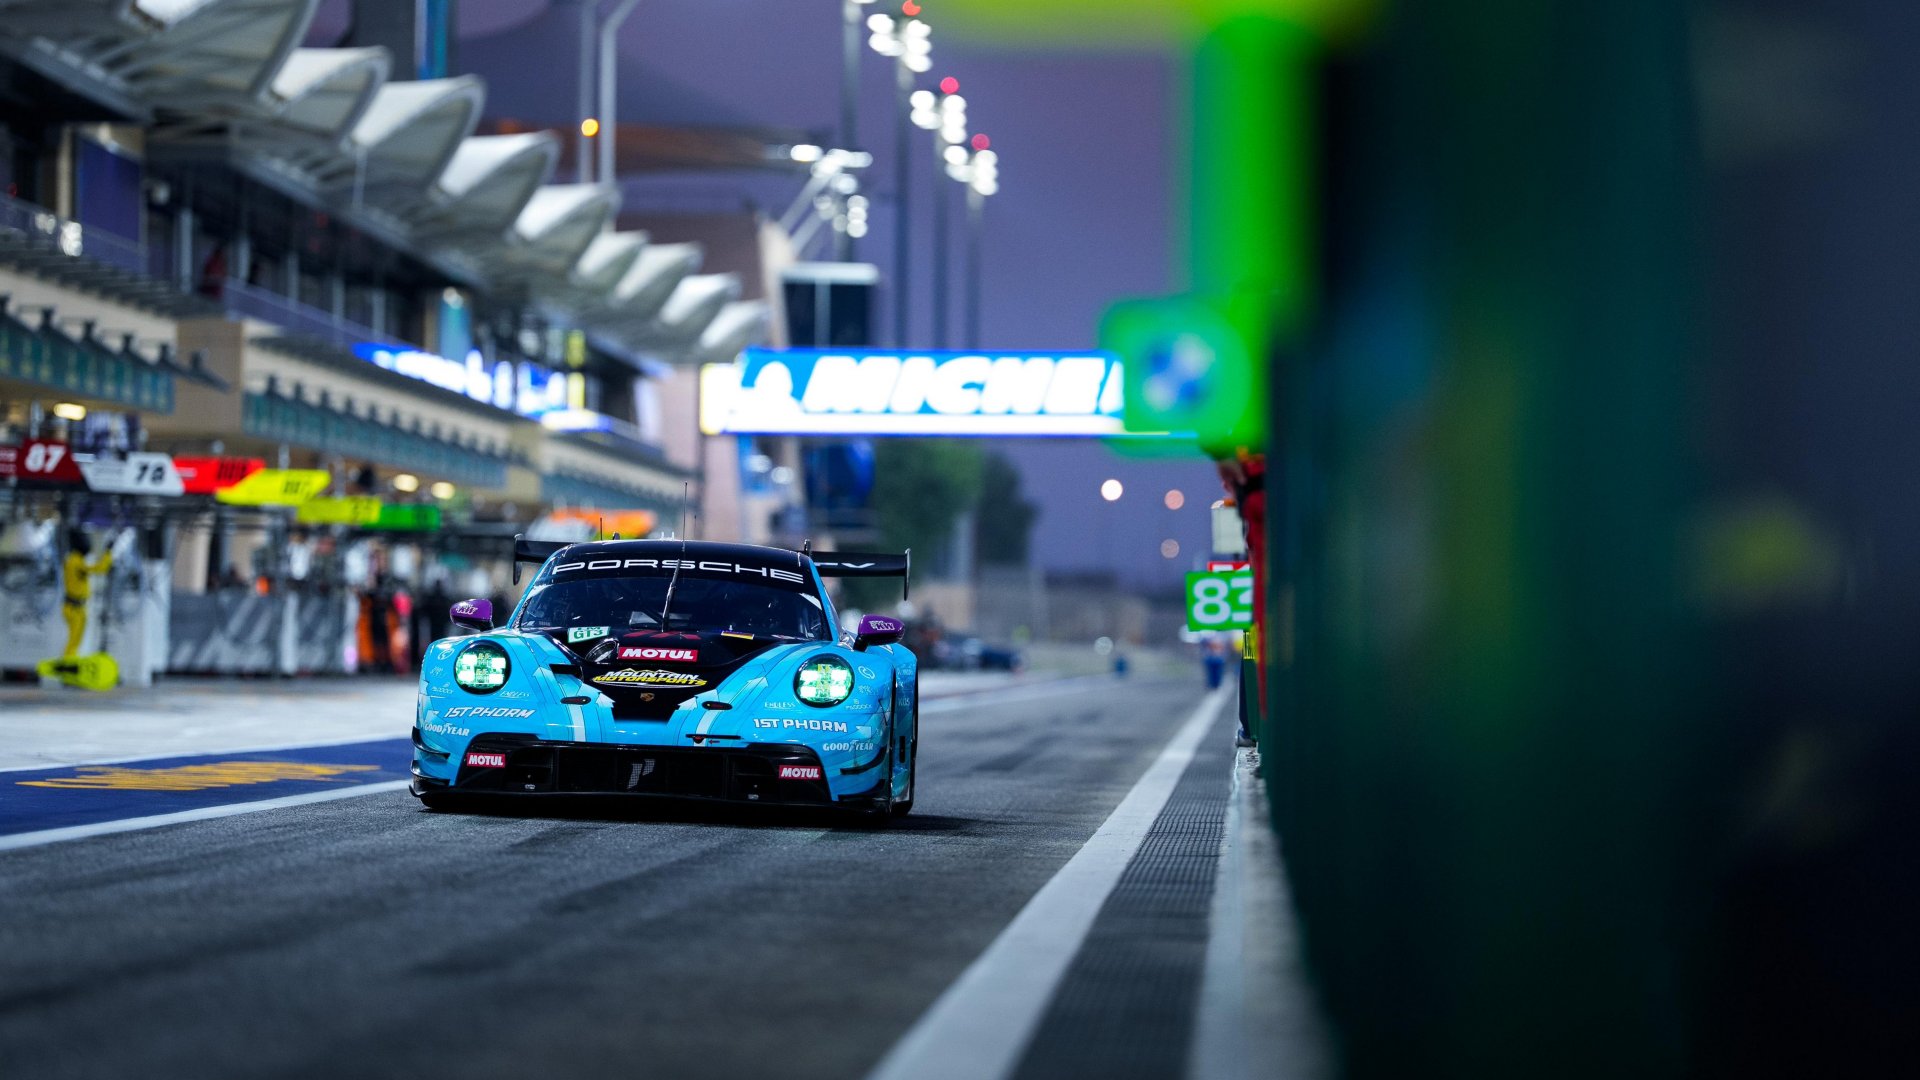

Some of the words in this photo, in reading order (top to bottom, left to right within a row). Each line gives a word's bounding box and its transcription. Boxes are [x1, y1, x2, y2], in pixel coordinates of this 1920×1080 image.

[25, 443, 66, 472] 87
[552, 559, 804, 584] PORSCHE
[1193, 577, 1254, 624] 83
[573, 630, 603, 639] GT3
[622, 648, 694, 660] MOTUL
[593, 676, 707, 686] MOTORSPORTS
[604, 671, 700, 680] MOUNTAIN
[444, 707, 472, 718] 1ST
[470, 707, 536, 719] PHORM
[424, 722, 470, 736] GOODYEAR
[754, 719, 779, 728] 1ST
[783, 719, 848, 733] PHORM
[822, 740, 874, 751] GOODYEAR
[468, 755, 504, 766] MOTUL
[780, 768, 819, 778] MOTUL
